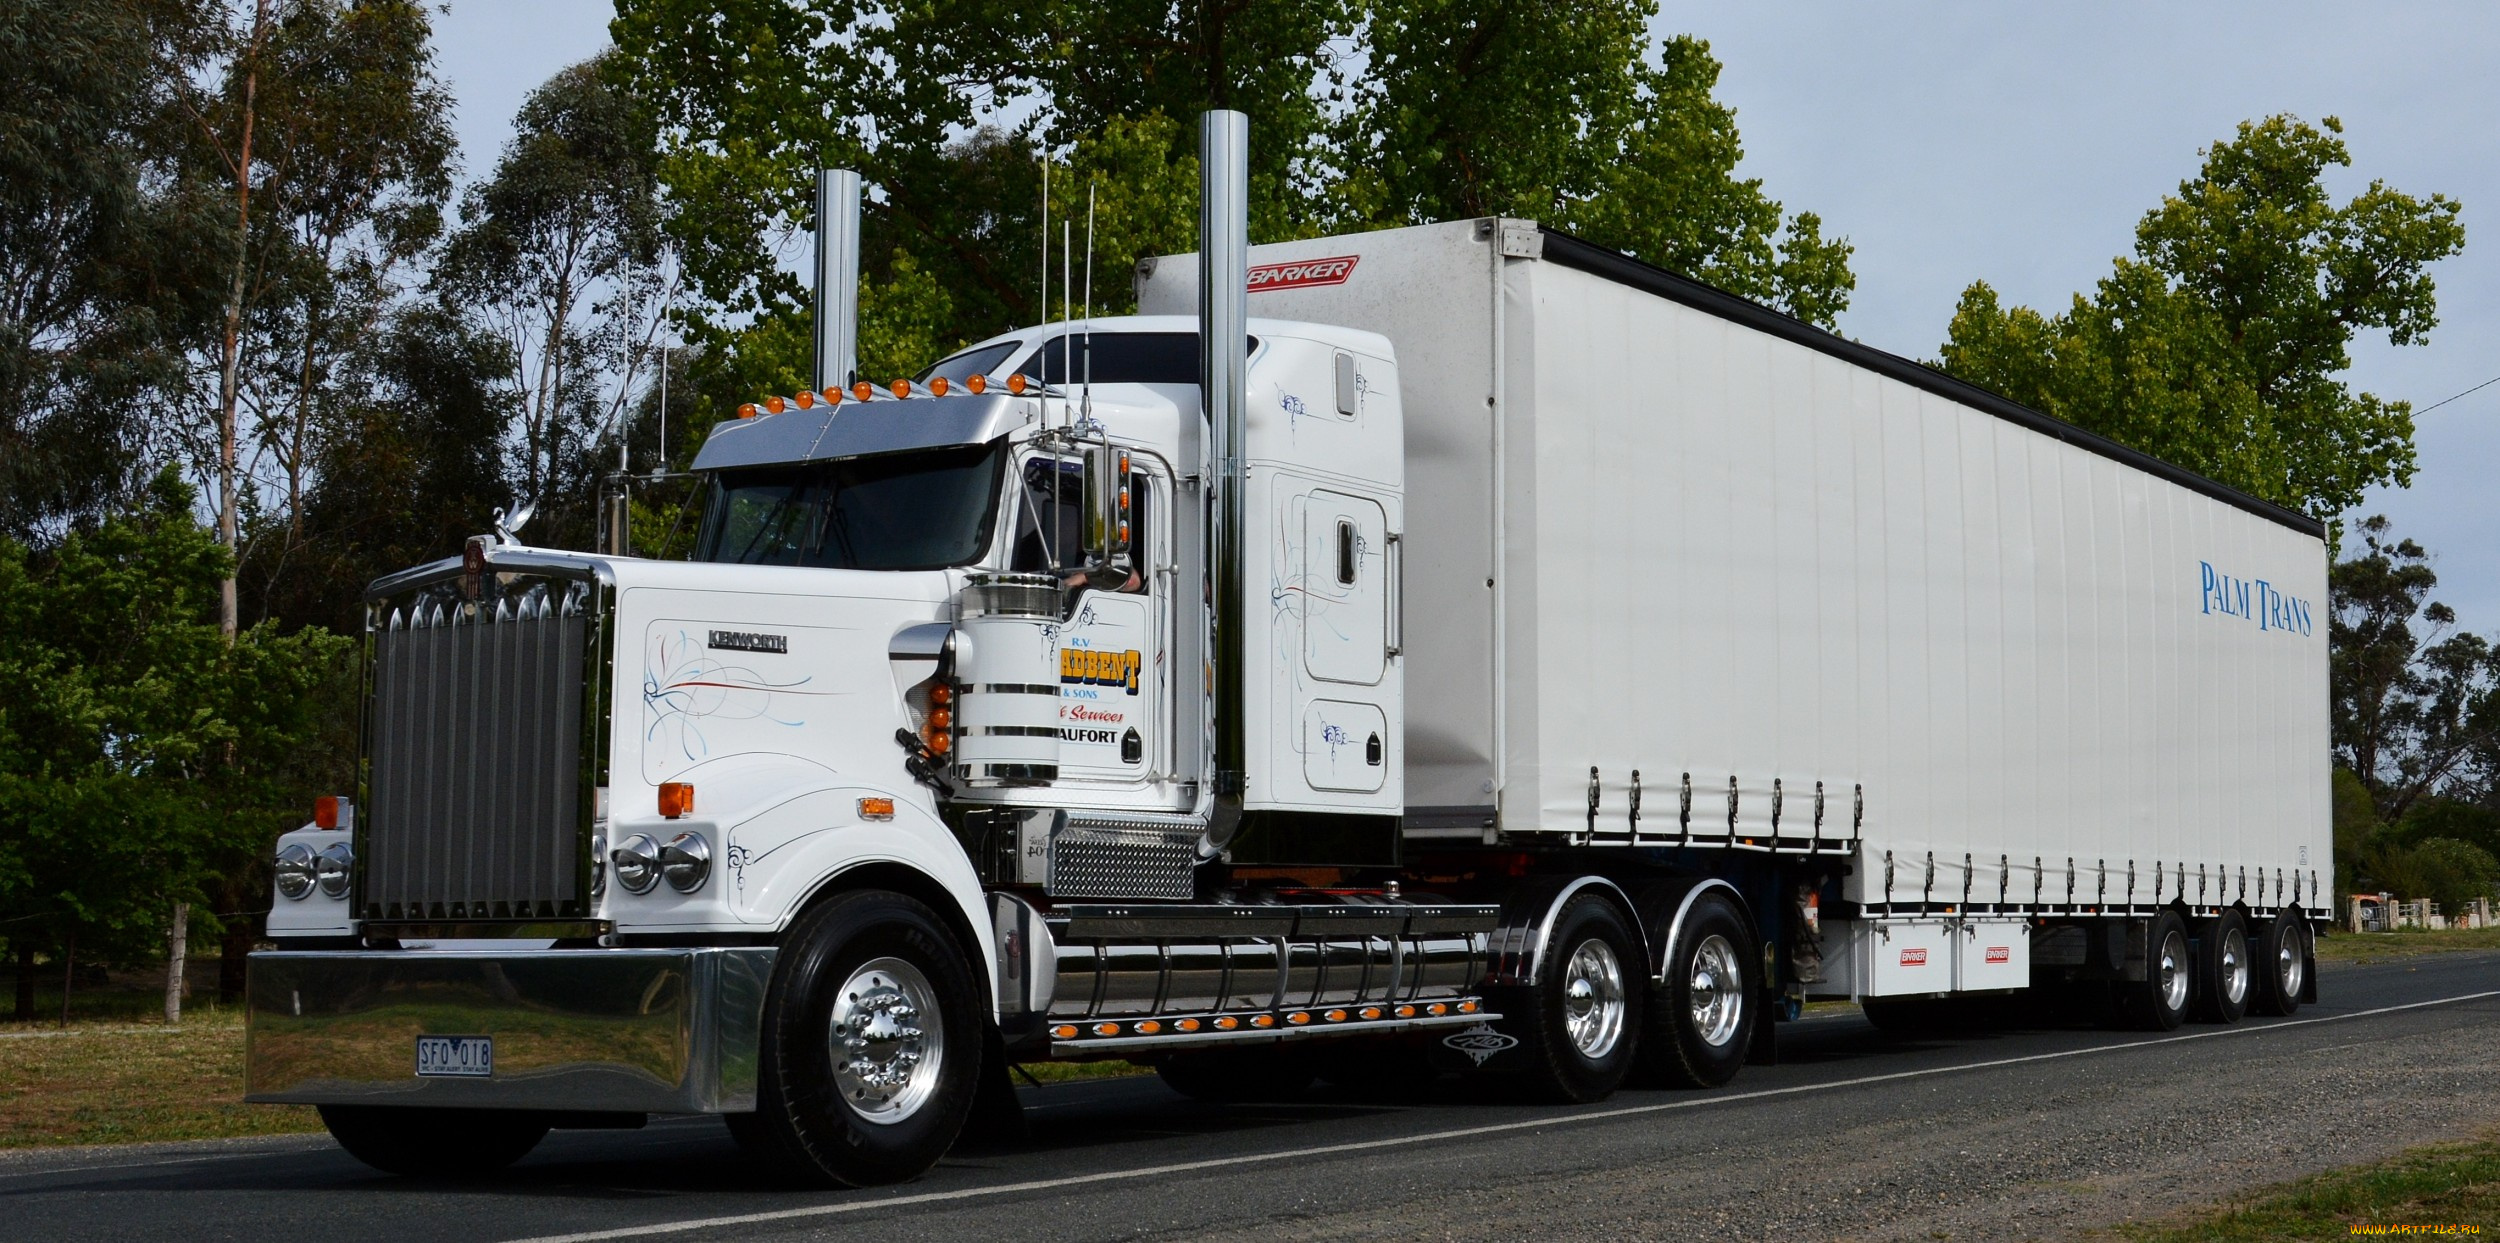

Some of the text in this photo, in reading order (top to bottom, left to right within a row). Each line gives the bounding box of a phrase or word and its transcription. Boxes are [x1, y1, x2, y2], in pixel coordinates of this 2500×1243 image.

[1247, 261, 1349, 284] BARKER
[2199, 560, 2311, 637] PALM TRANS
[708, 629, 788, 650] KENWORTH
[1063, 689, 1098, 700] & SONS
[1069, 704, 1124, 723] Services
[461, 1043, 489, 1066] 018
